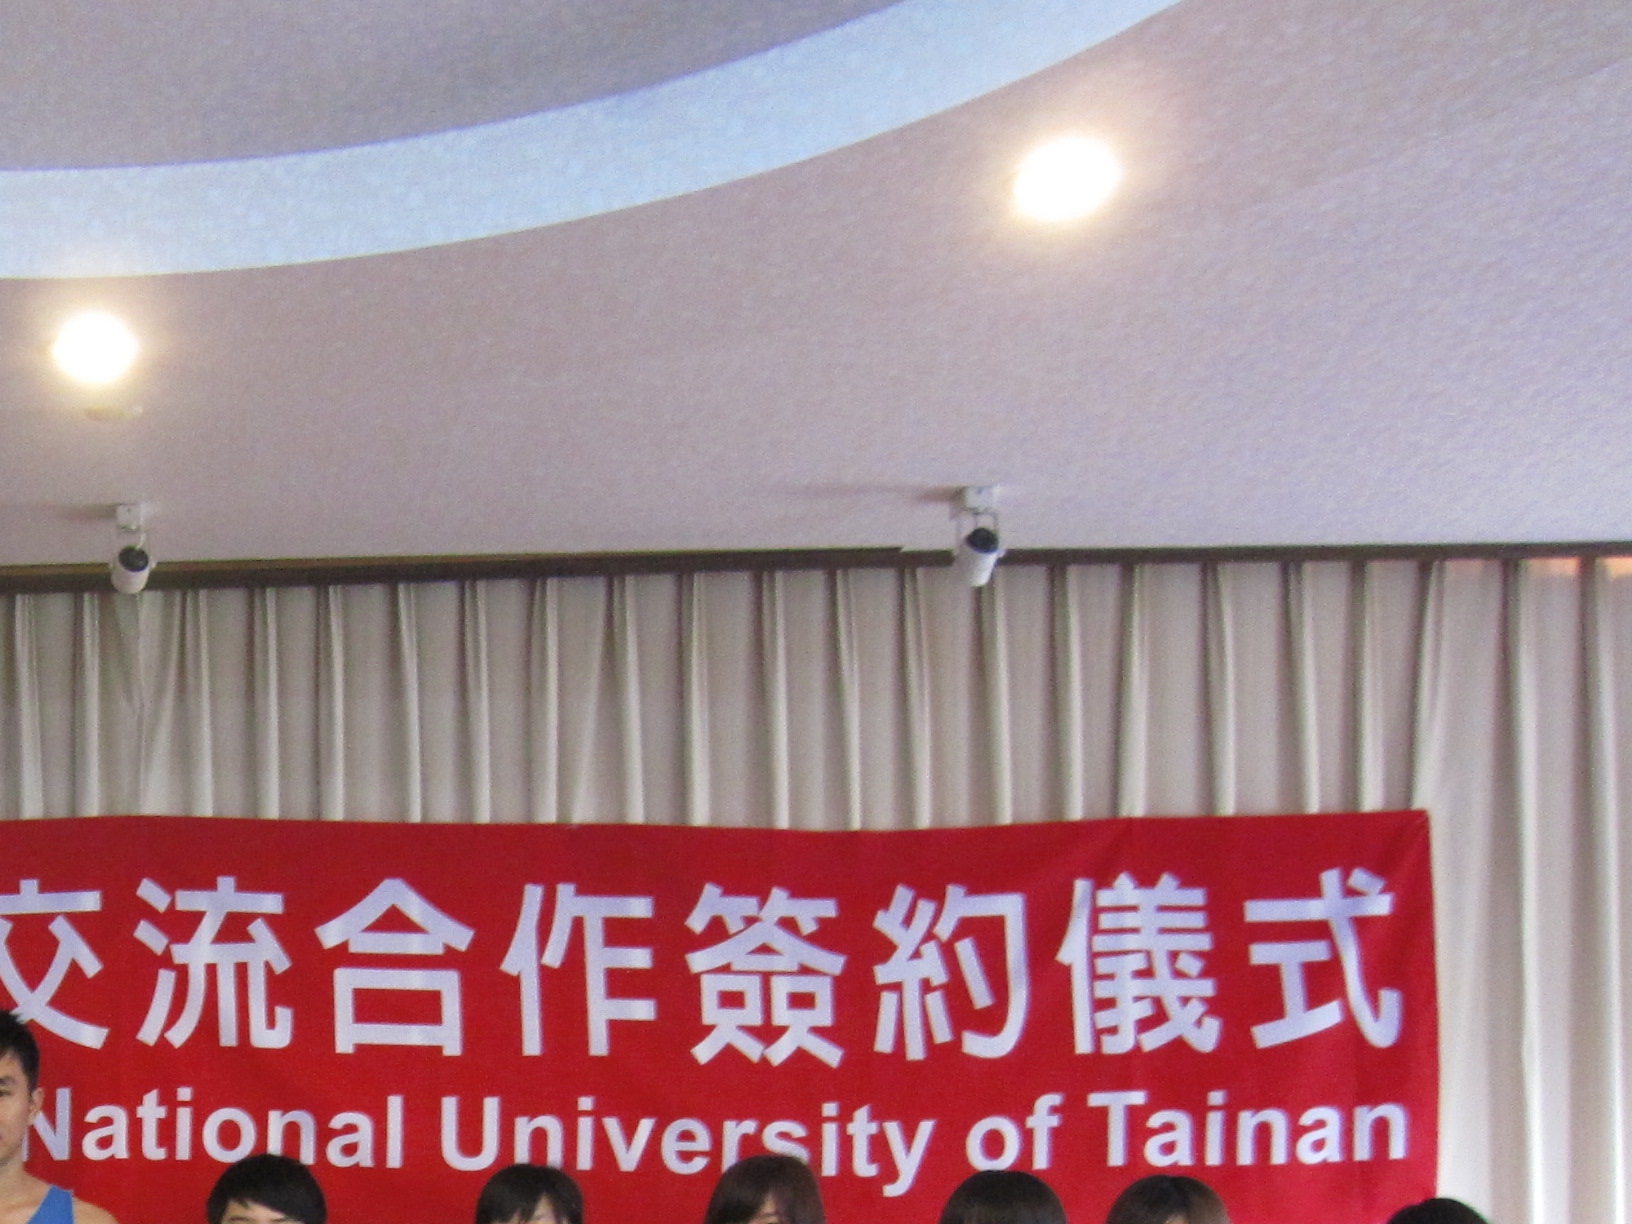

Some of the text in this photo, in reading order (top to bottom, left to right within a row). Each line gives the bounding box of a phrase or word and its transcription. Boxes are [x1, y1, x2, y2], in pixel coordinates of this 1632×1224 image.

[22, 1087, 405, 1169] National
[441, 1096, 936, 1197] University
[966, 1094, 1063, 1170] of
[1087, 1090, 1409, 1168] Tainan
